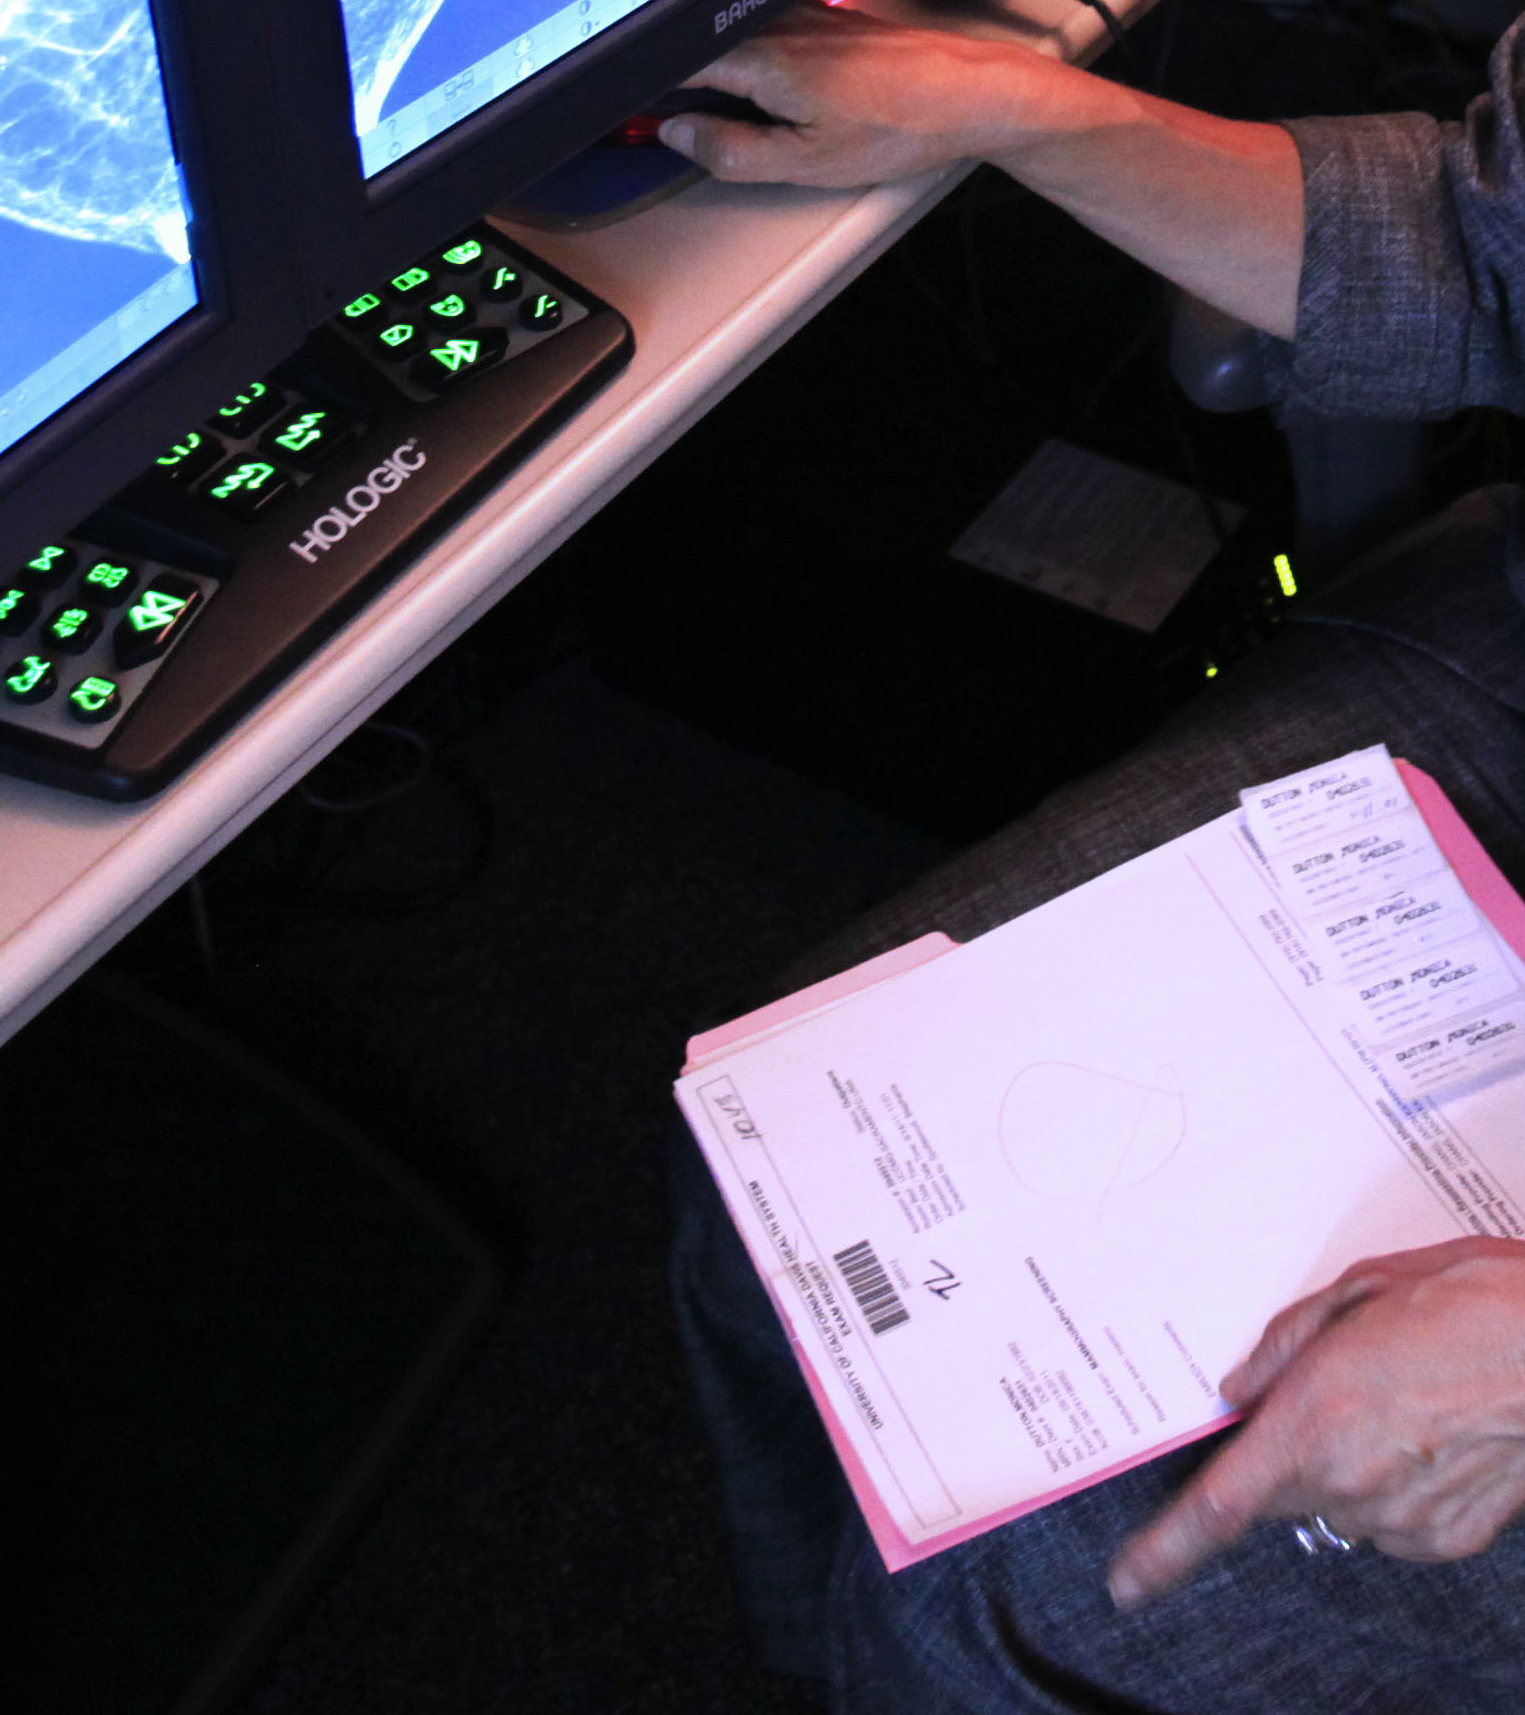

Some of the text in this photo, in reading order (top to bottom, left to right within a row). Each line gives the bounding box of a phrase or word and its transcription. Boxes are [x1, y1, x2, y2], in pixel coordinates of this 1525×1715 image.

[289, 443, 427, 563] HOLOGIC
[746, 1177, 885, 1431] UNIVERSITY OF CALIFORNIA DAVIS HEALTH SYSTEM
[803, 1258, 854, 1338] EXAM REQUEST
[1023, 1254, 1059, 1304] SCREENING
[1051, 1301, 1100, 1371] MAMMOGRAPHY
